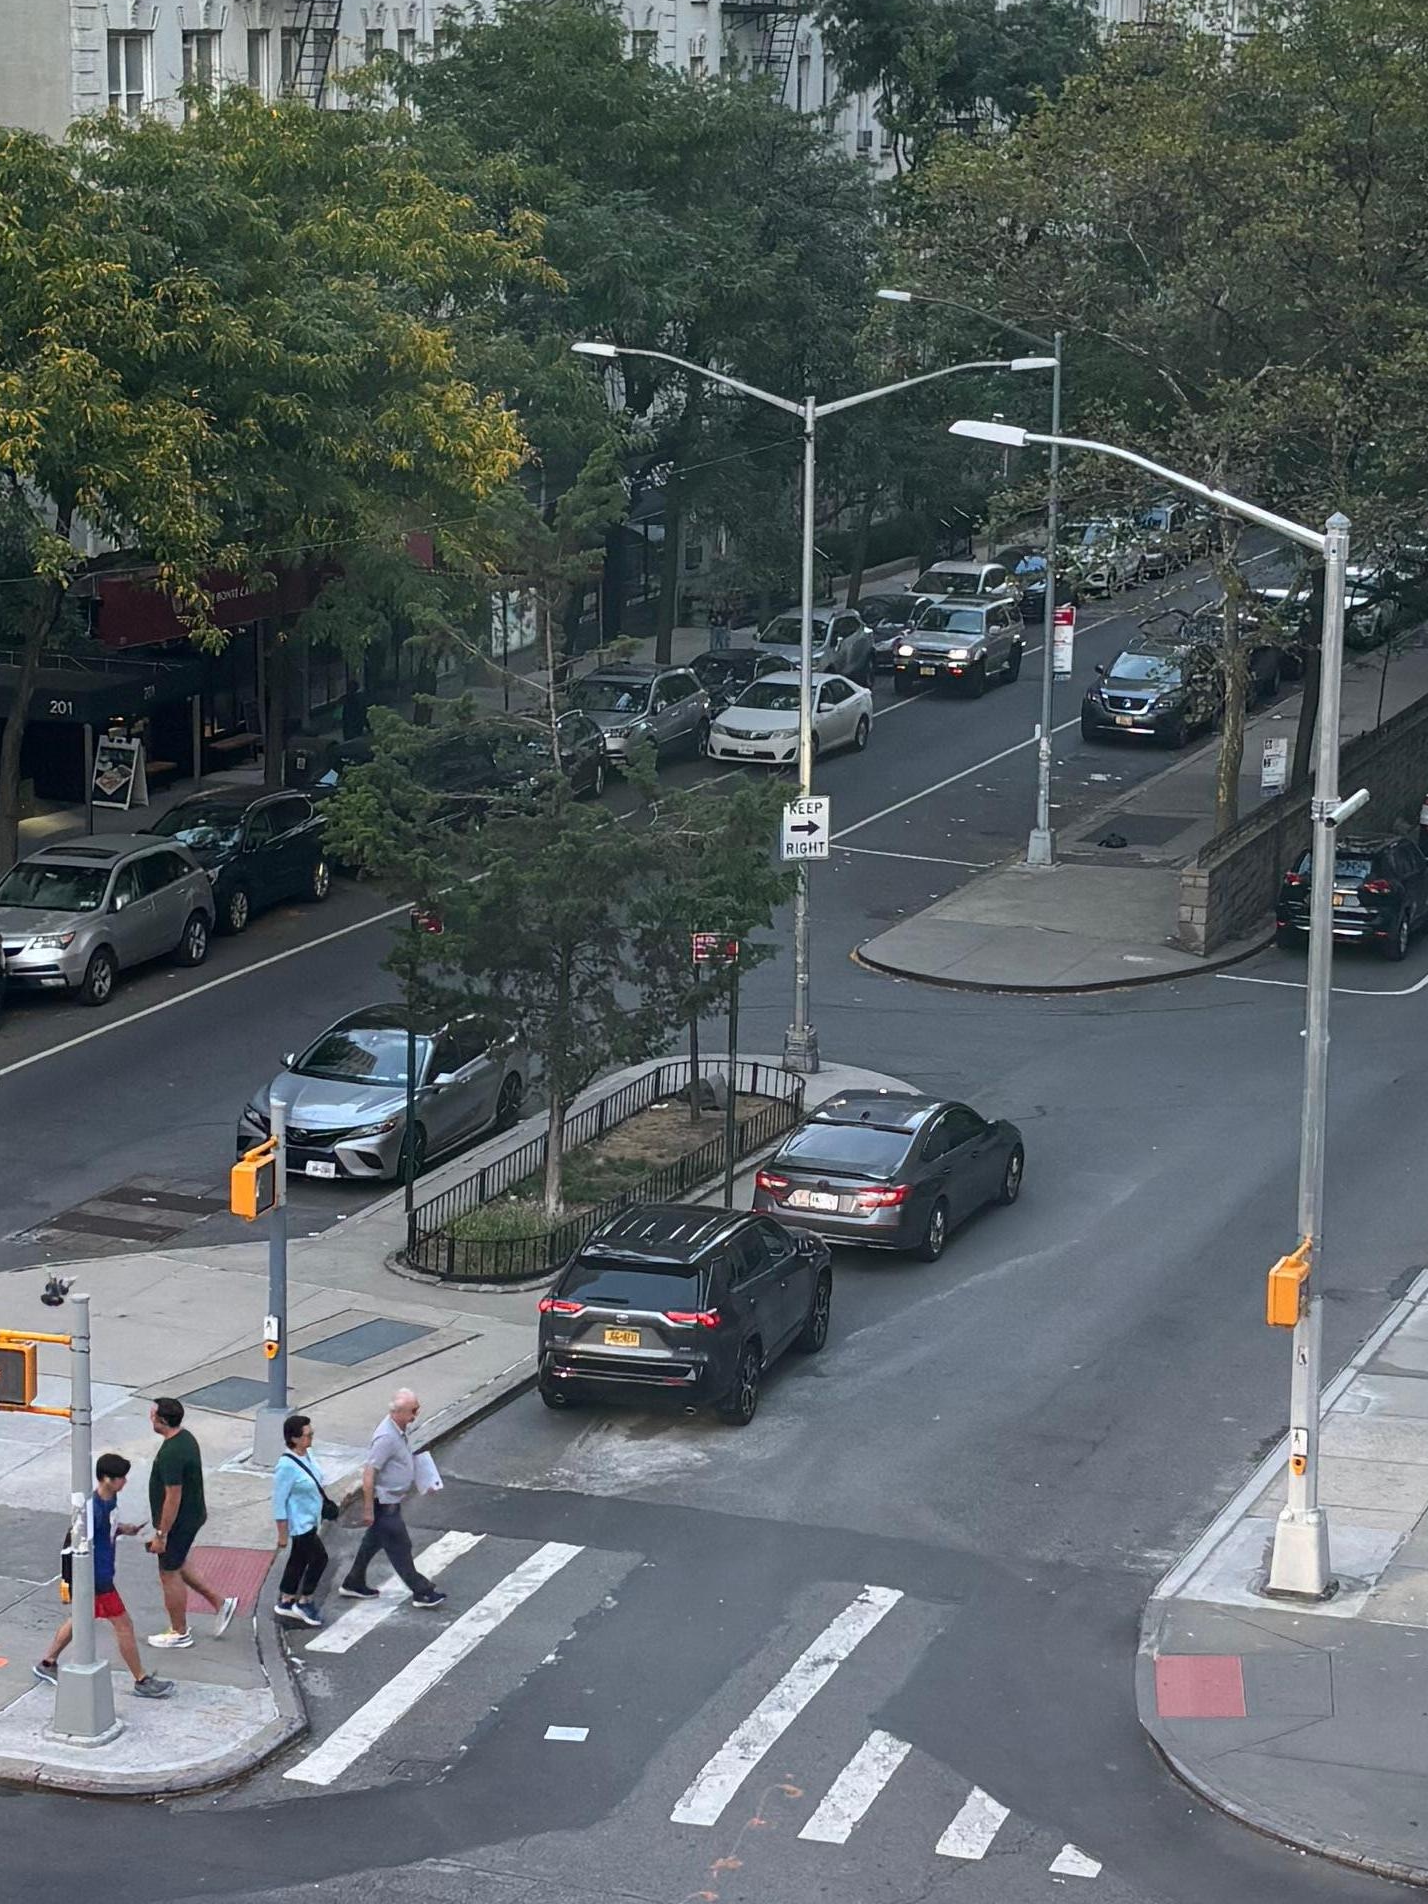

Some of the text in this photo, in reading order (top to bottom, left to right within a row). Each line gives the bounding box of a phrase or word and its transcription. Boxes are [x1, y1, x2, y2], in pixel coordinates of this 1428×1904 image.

[49, 699, 73, 715] 201
[789, 802, 823, 815] KEEP
[786, 841, 825, 855] RIGHT
